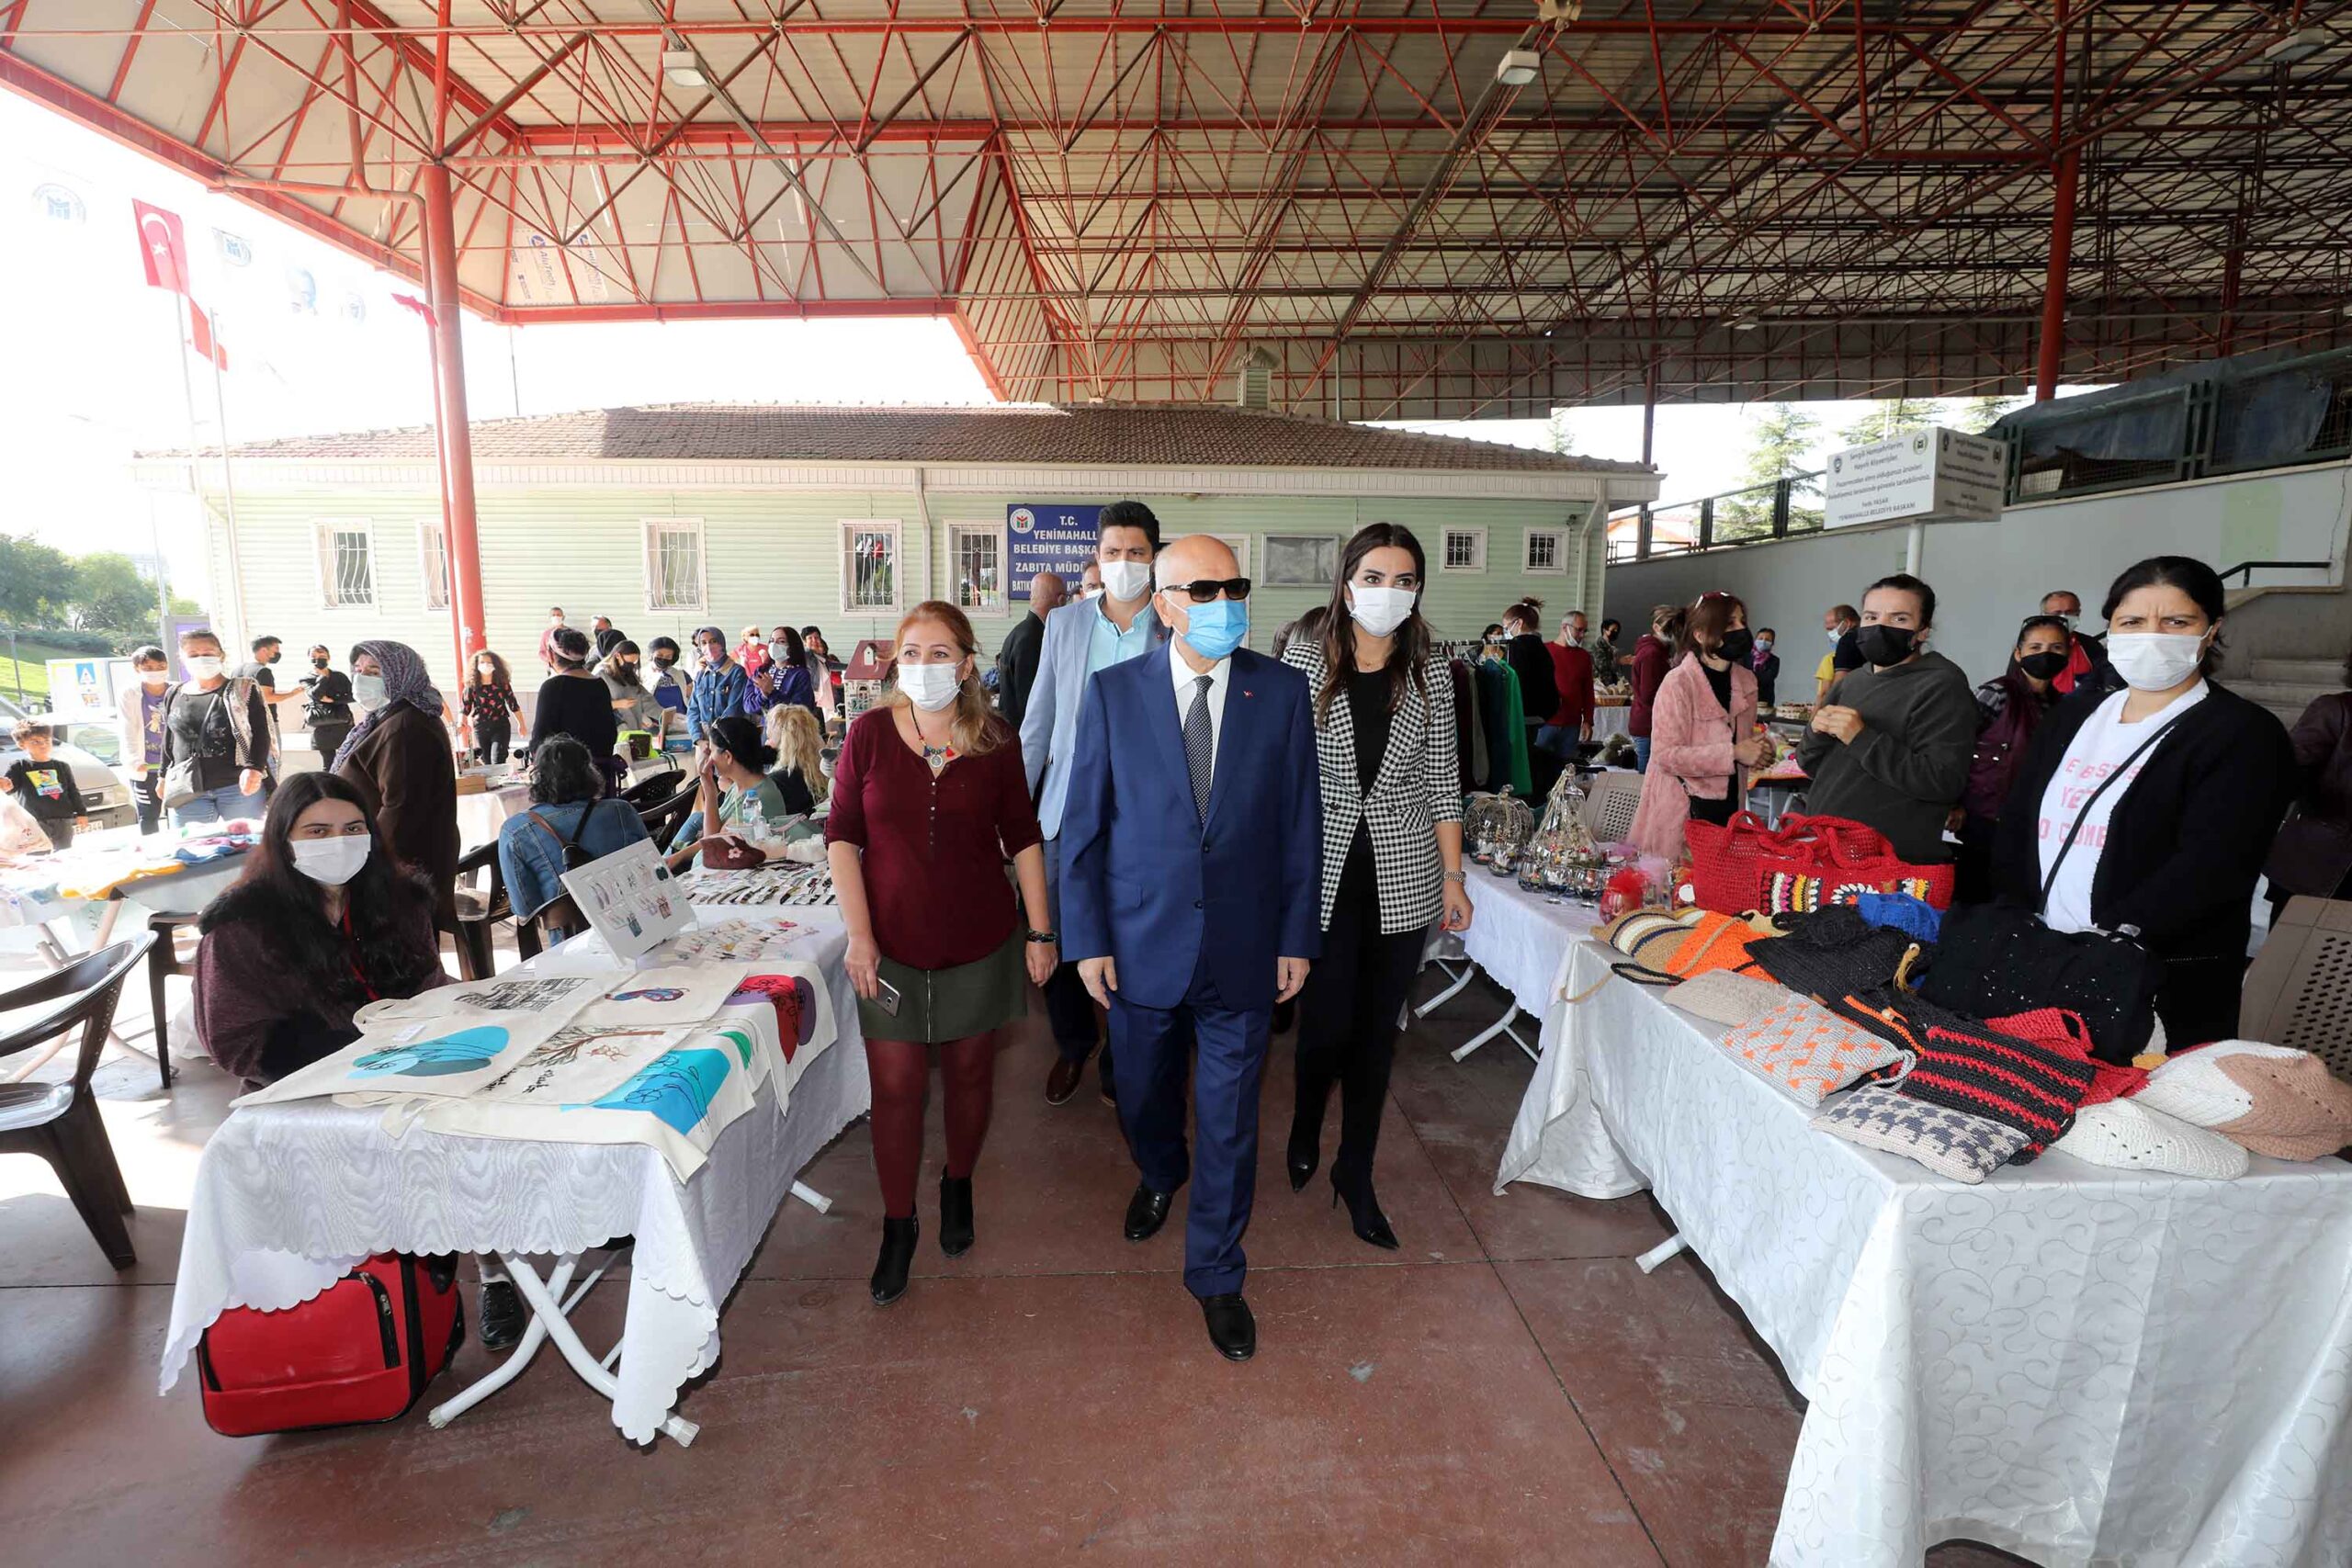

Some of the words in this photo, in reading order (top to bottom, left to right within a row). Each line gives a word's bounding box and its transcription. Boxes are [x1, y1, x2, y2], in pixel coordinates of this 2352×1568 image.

[1059, 516, 1079, 526] T.C.
[1033, 528, 1098, 541] YENİMAHALL
[1013, 542, 1062, 555] BELEDİYE
[1064, 544, 1097, 558] BAŞKA
[1015, 562, 1053, 573] ZABITA
[1012, 580, 1031, 592] BATIK
